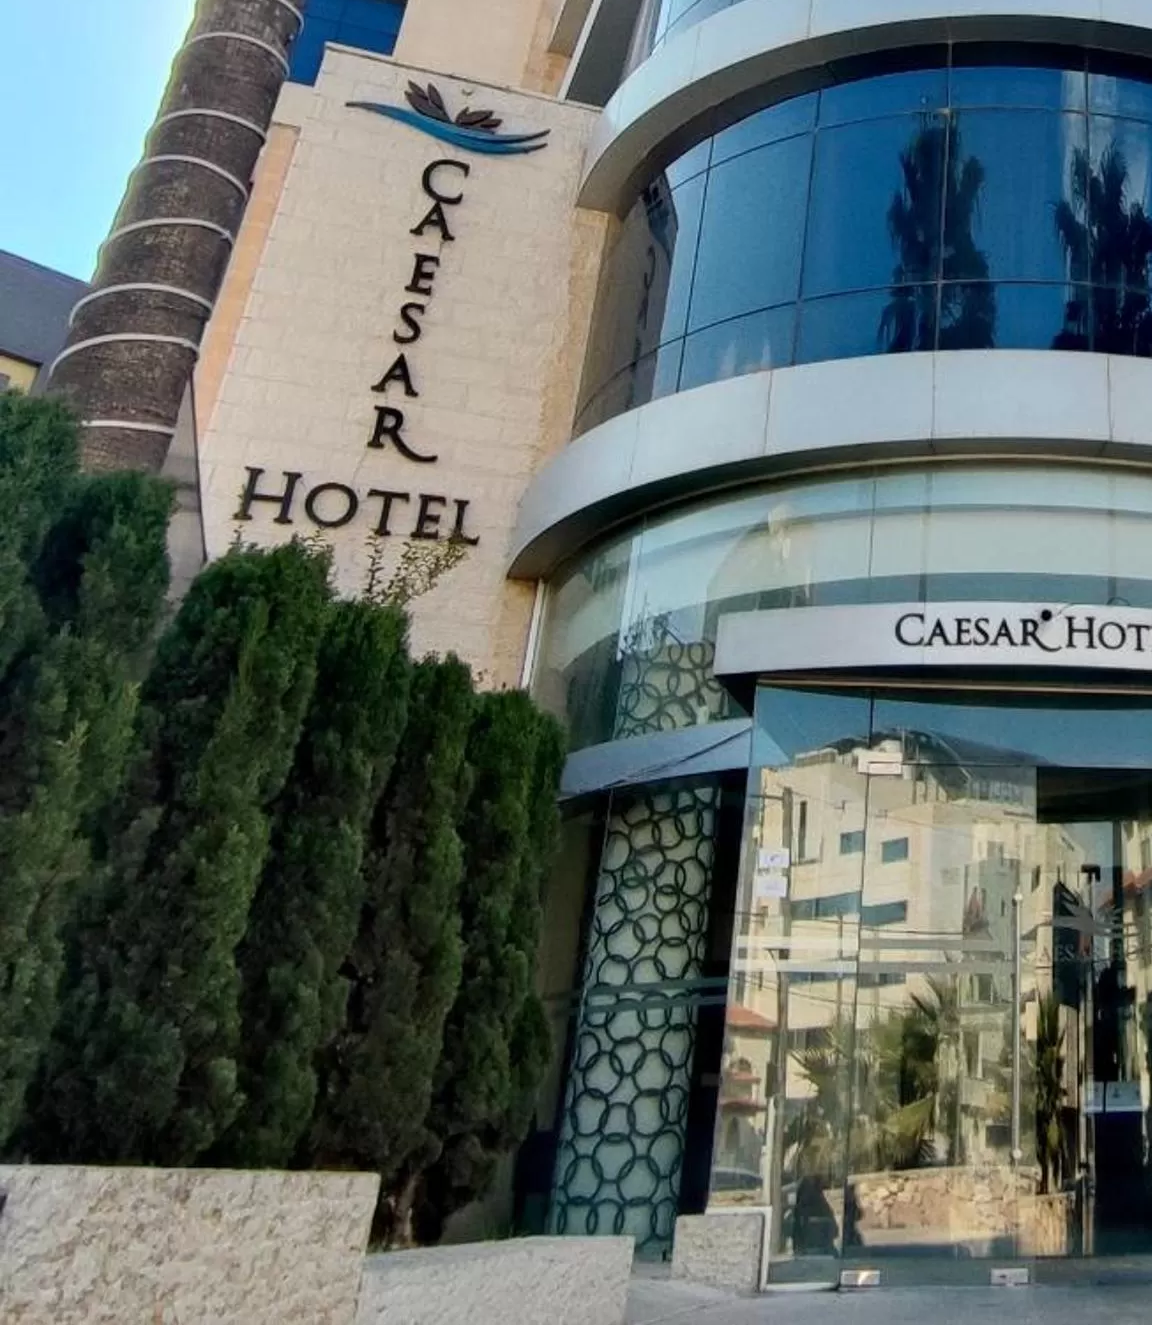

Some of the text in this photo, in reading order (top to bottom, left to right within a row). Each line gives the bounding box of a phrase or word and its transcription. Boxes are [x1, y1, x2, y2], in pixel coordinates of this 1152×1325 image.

[366, 159, 470, 463] CAESAR
[233, 466, 481, 546] HOTEL
[895, 613, 1062, 652] CAESAR
